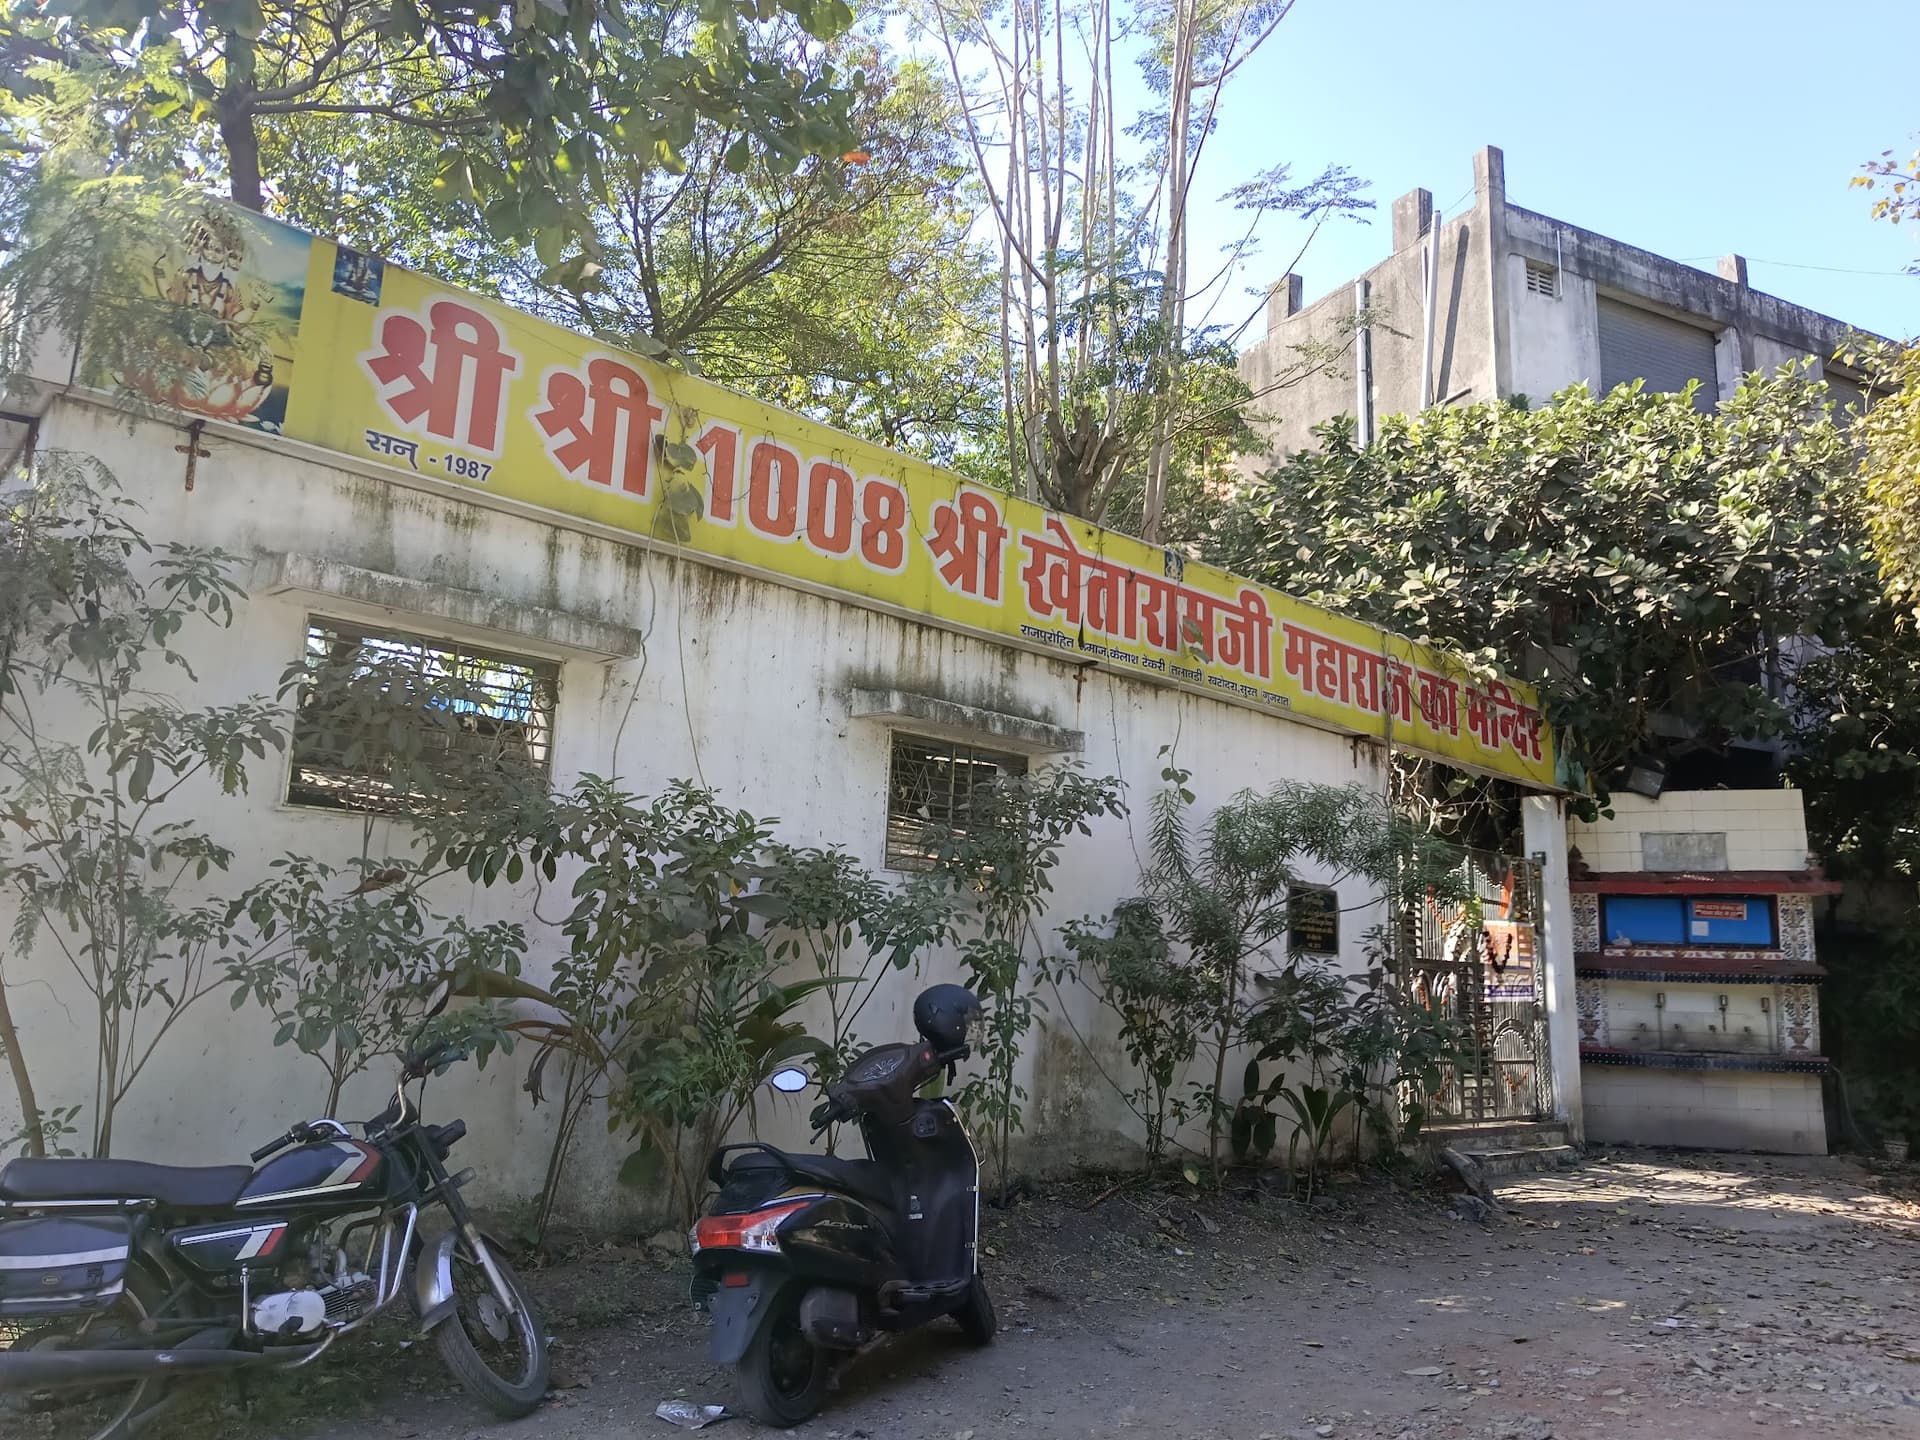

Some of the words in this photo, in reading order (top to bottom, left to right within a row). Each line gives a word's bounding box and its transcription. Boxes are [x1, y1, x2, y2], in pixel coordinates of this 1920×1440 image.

[366, 429, 419, 470] सन्
[444, 454, 492, 482] 1987
[367, 302, 516, 452] श्री
[535, 358, 662, 497] श्री
[696, 426, 906, 569] 1008
[927, 491, 1008, 601] श्री
